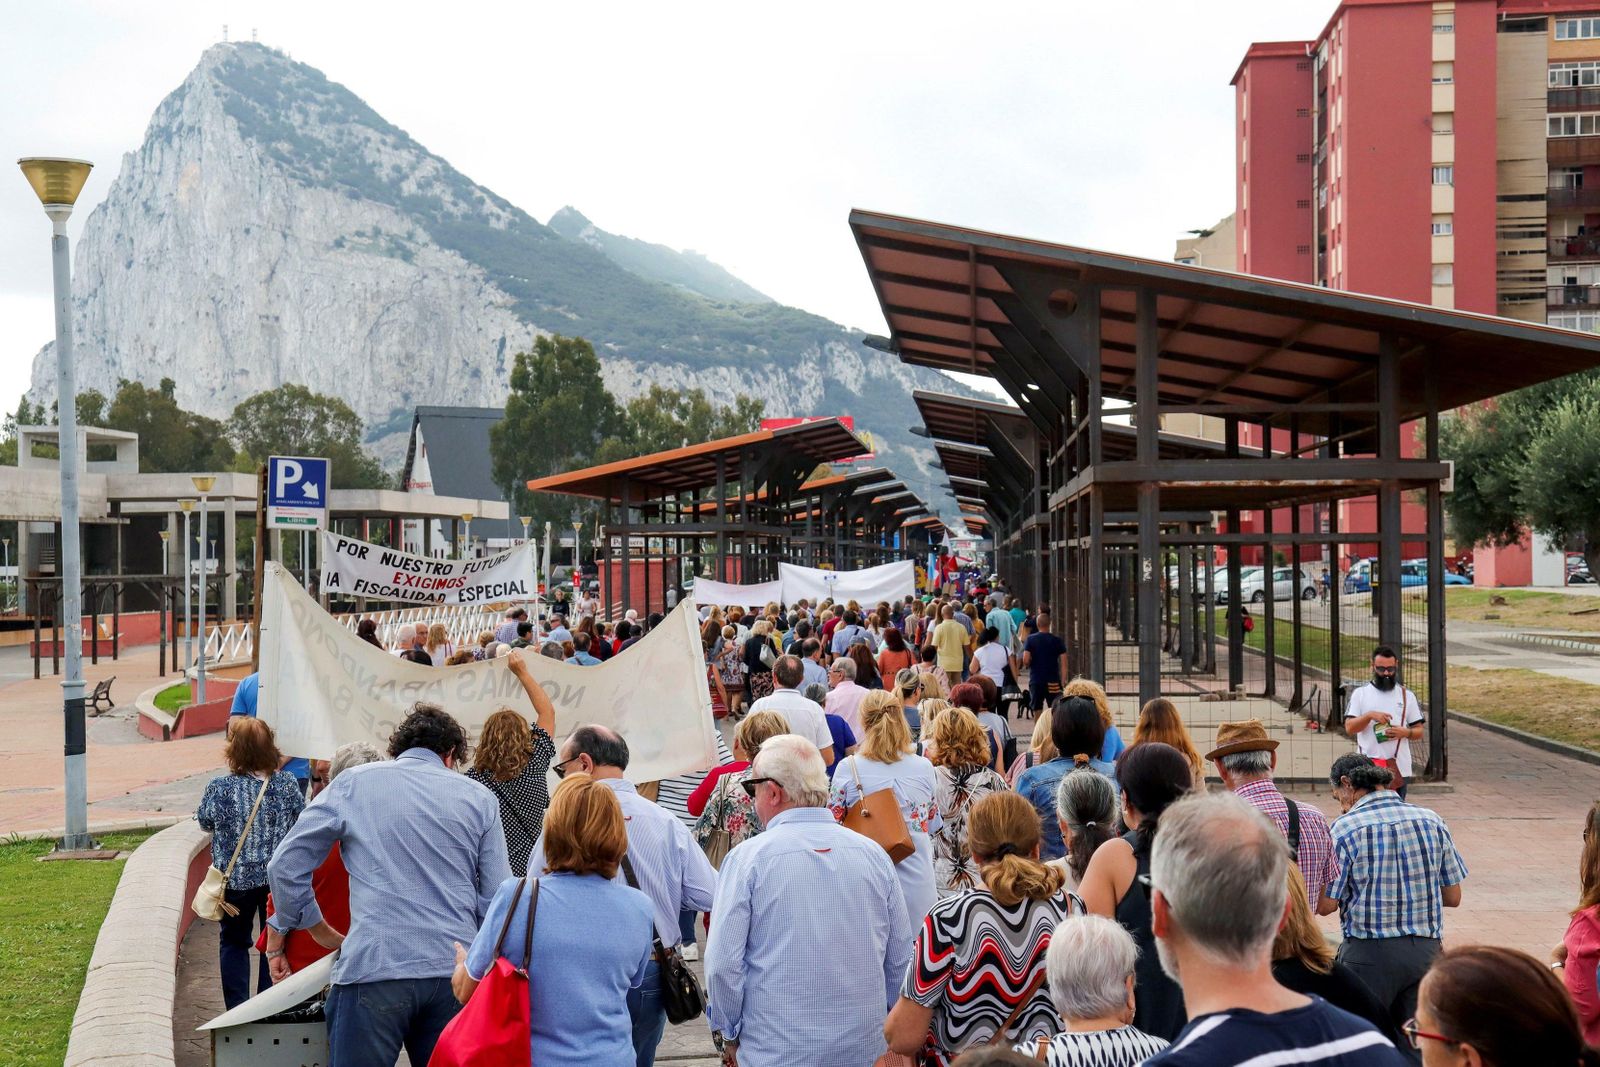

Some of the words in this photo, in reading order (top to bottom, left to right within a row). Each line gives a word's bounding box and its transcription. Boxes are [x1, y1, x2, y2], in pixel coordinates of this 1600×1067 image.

[276, 459, 303, 498] P
[336, 538, 370, 560] POR
[380, 551, 454, 576] NUESTRO
[462, 552, 513, 575] FUTURO
[353, 579, 447, 604] FISCALIDAD
[458, 579, 529, 603] ESPECIAL
[392, 571, 467, 590] EXIGIMOS
